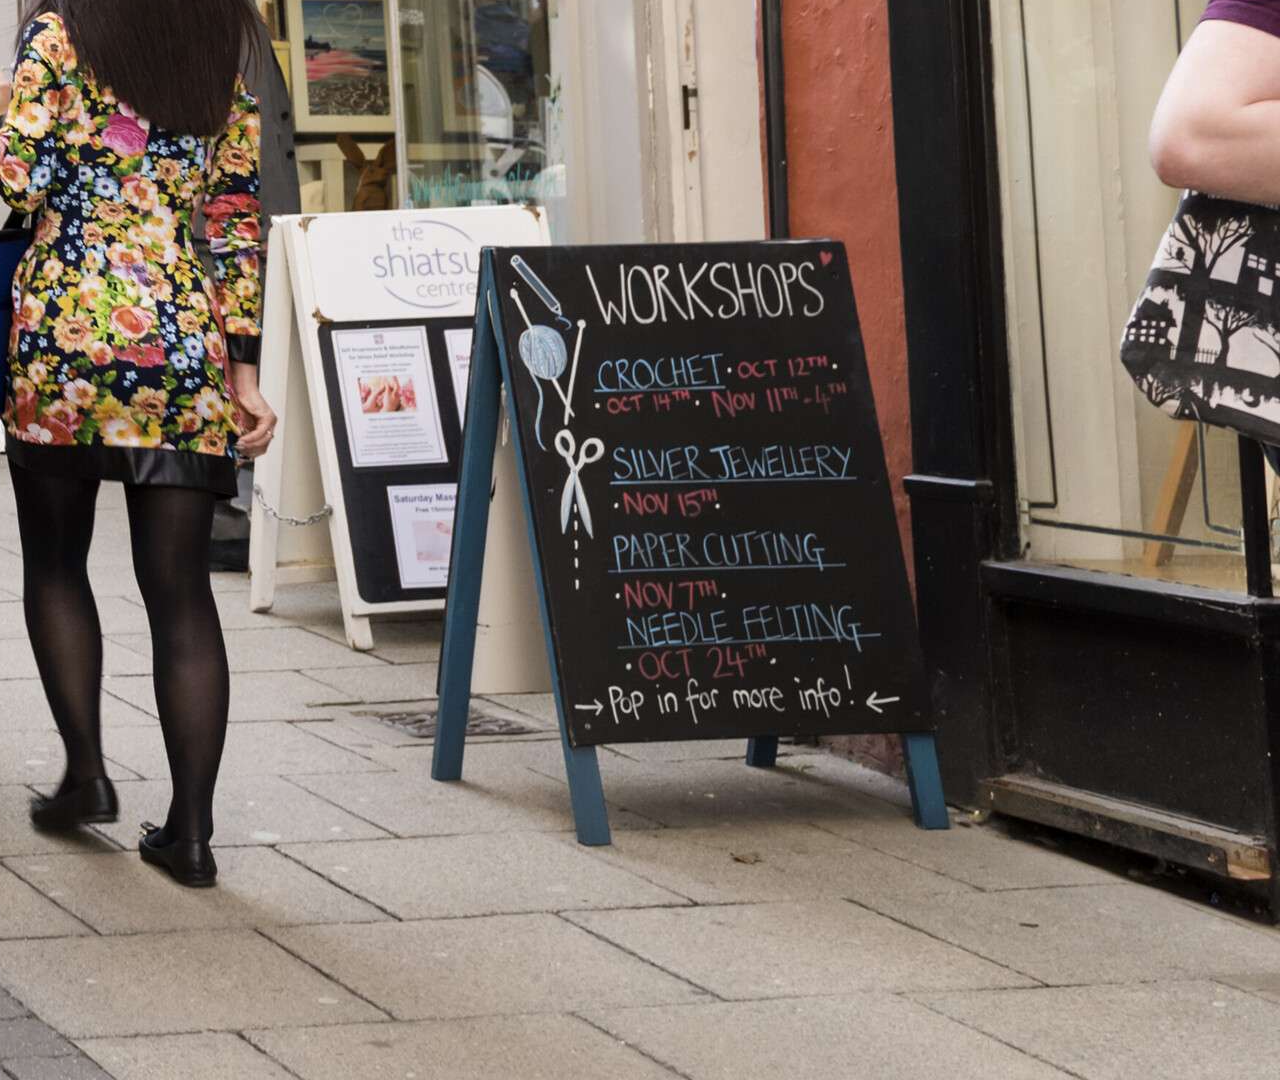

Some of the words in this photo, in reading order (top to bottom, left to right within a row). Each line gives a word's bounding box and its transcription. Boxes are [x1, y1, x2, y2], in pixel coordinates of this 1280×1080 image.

[392, 221, 424, 241] the
[372, 243, 480, 278] shiatsu
[416, 281, 477, 298] centre
[585, 261, 825, 325] WORKSHOPS
[597, 353, 724, 390] CROCHET
[737, 360, 778, 379] OCT
[788, 355, 829, 377] 12TH
[607, 394, 644, 414] OCT
[653, 390, 691, 412] 14TH
[766, 387, 799, 412] 11TH
[612, 445, 709, 480] SILVER
[710, 445, 854, 480] JEWELLERY
[394, 494, 433, 503] Saturday
[623, 491, 670, 516] NOV
[677, 488, 719, 518] 15TH
[612, 533, 699, 572] PAPER
[703, 531, 825, 571] CUTTING
[623, 580, 673, 610] NOV
[678, 579, 719, 610] 7TH
[626, 609, 733, 647] NEEDLE
[742, 603, 862, 652] FELTING
[639, 648, 693, 680] OCT
[706, 643, 767, 679] 24TH
[608, 685, 645, 724] Pop
[656, 683, 678, 714] in
[686, 678, 718, 724] for
[733, 686, 785, 712] more
